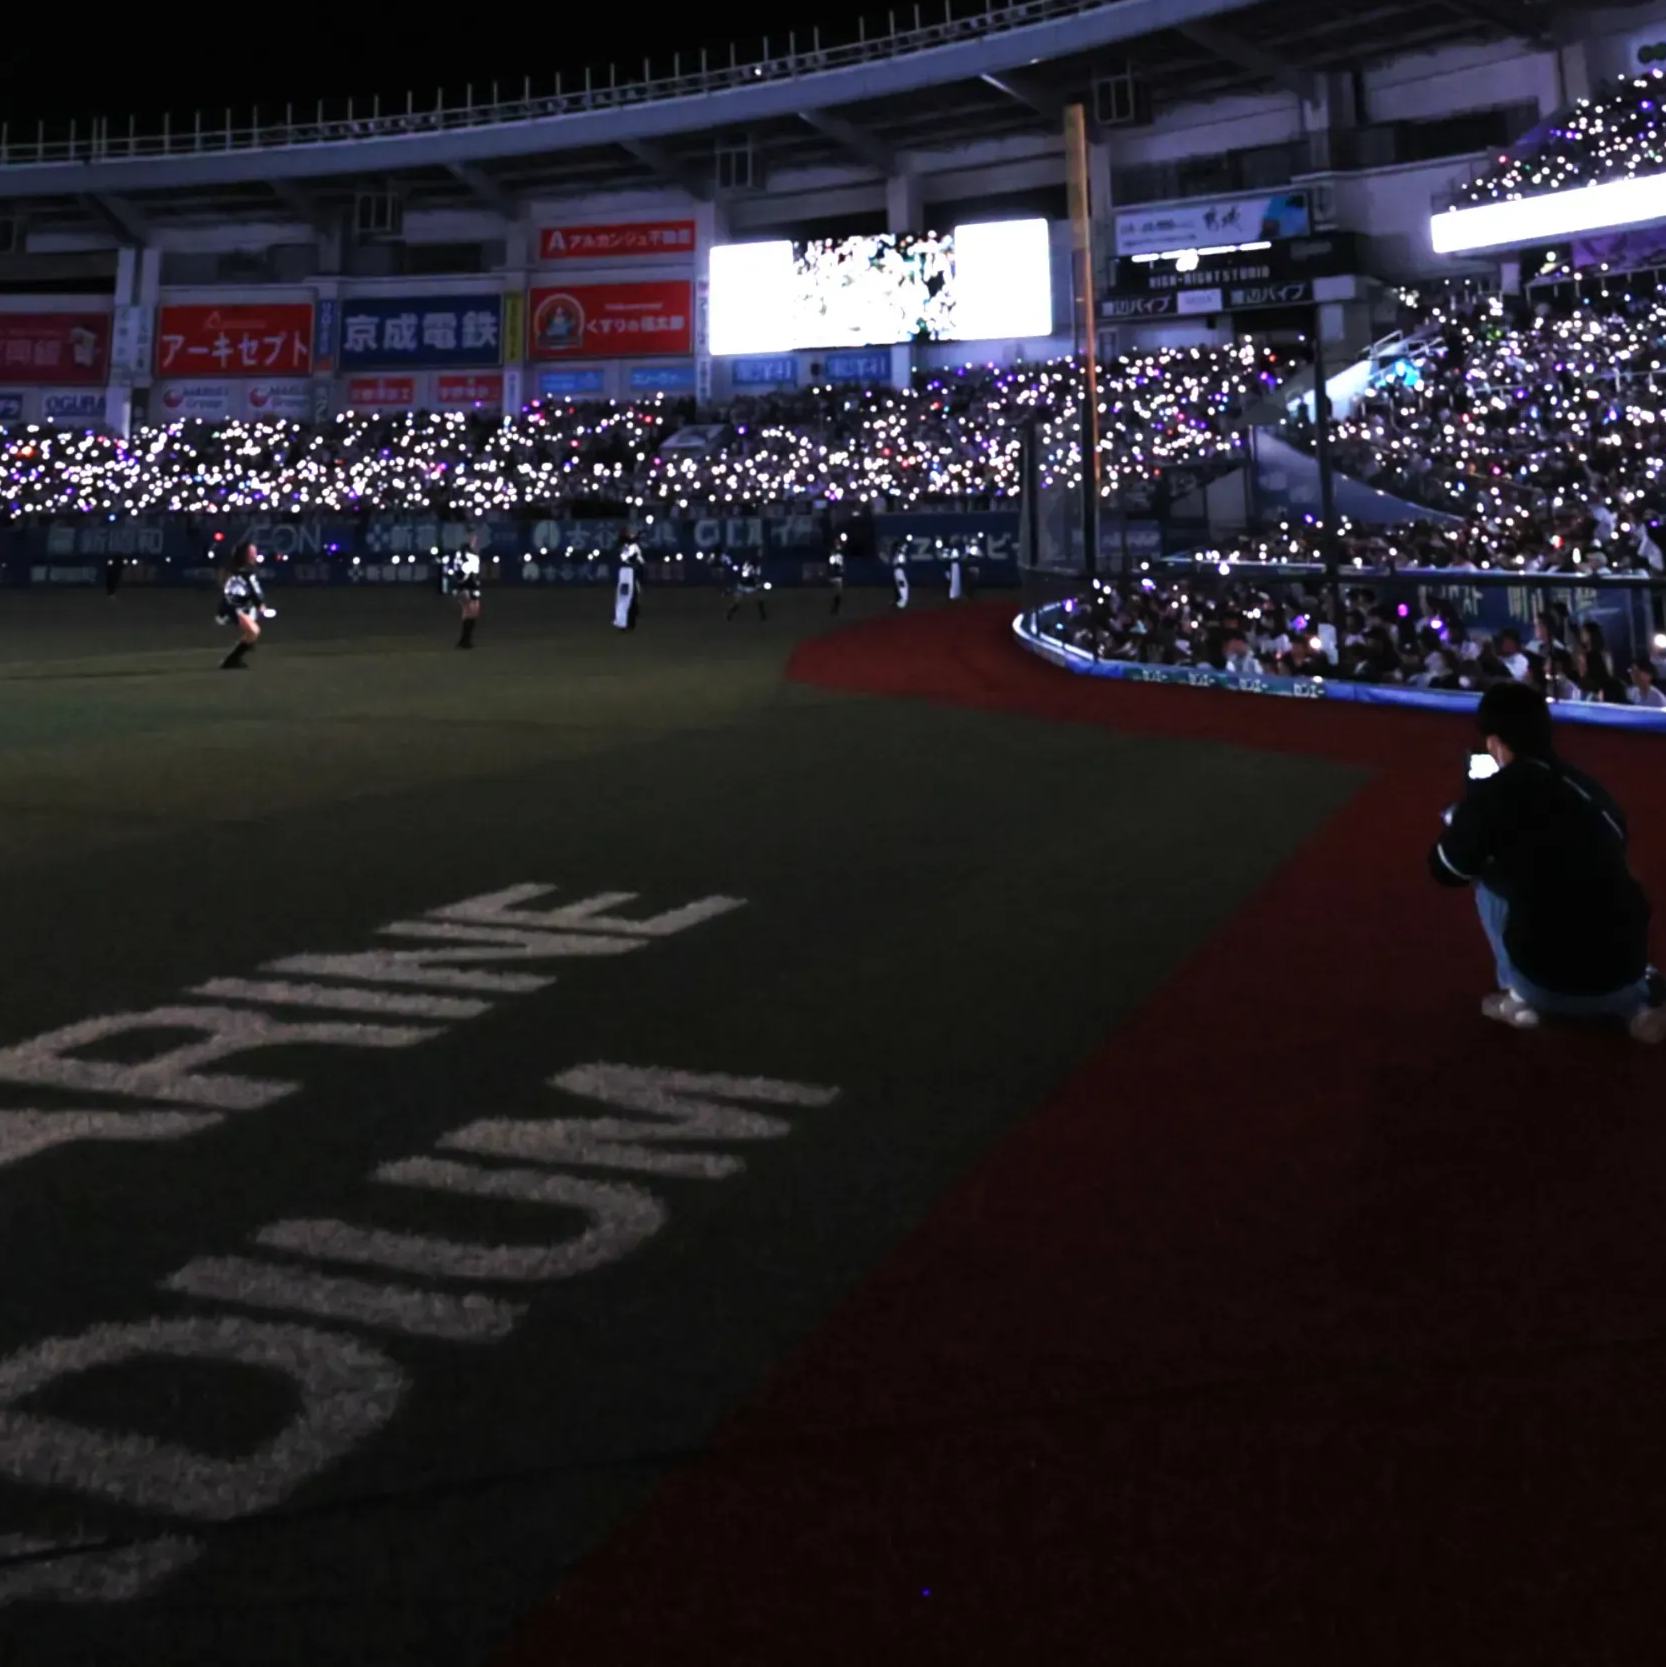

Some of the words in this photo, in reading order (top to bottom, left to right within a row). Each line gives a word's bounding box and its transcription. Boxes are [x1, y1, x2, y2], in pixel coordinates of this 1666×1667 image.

[343, 309, 499, 353] 京成電鉄
[585, 314, 686, 334] くすりの福太郎
[161, 330, 309, 369] アーキセプト
